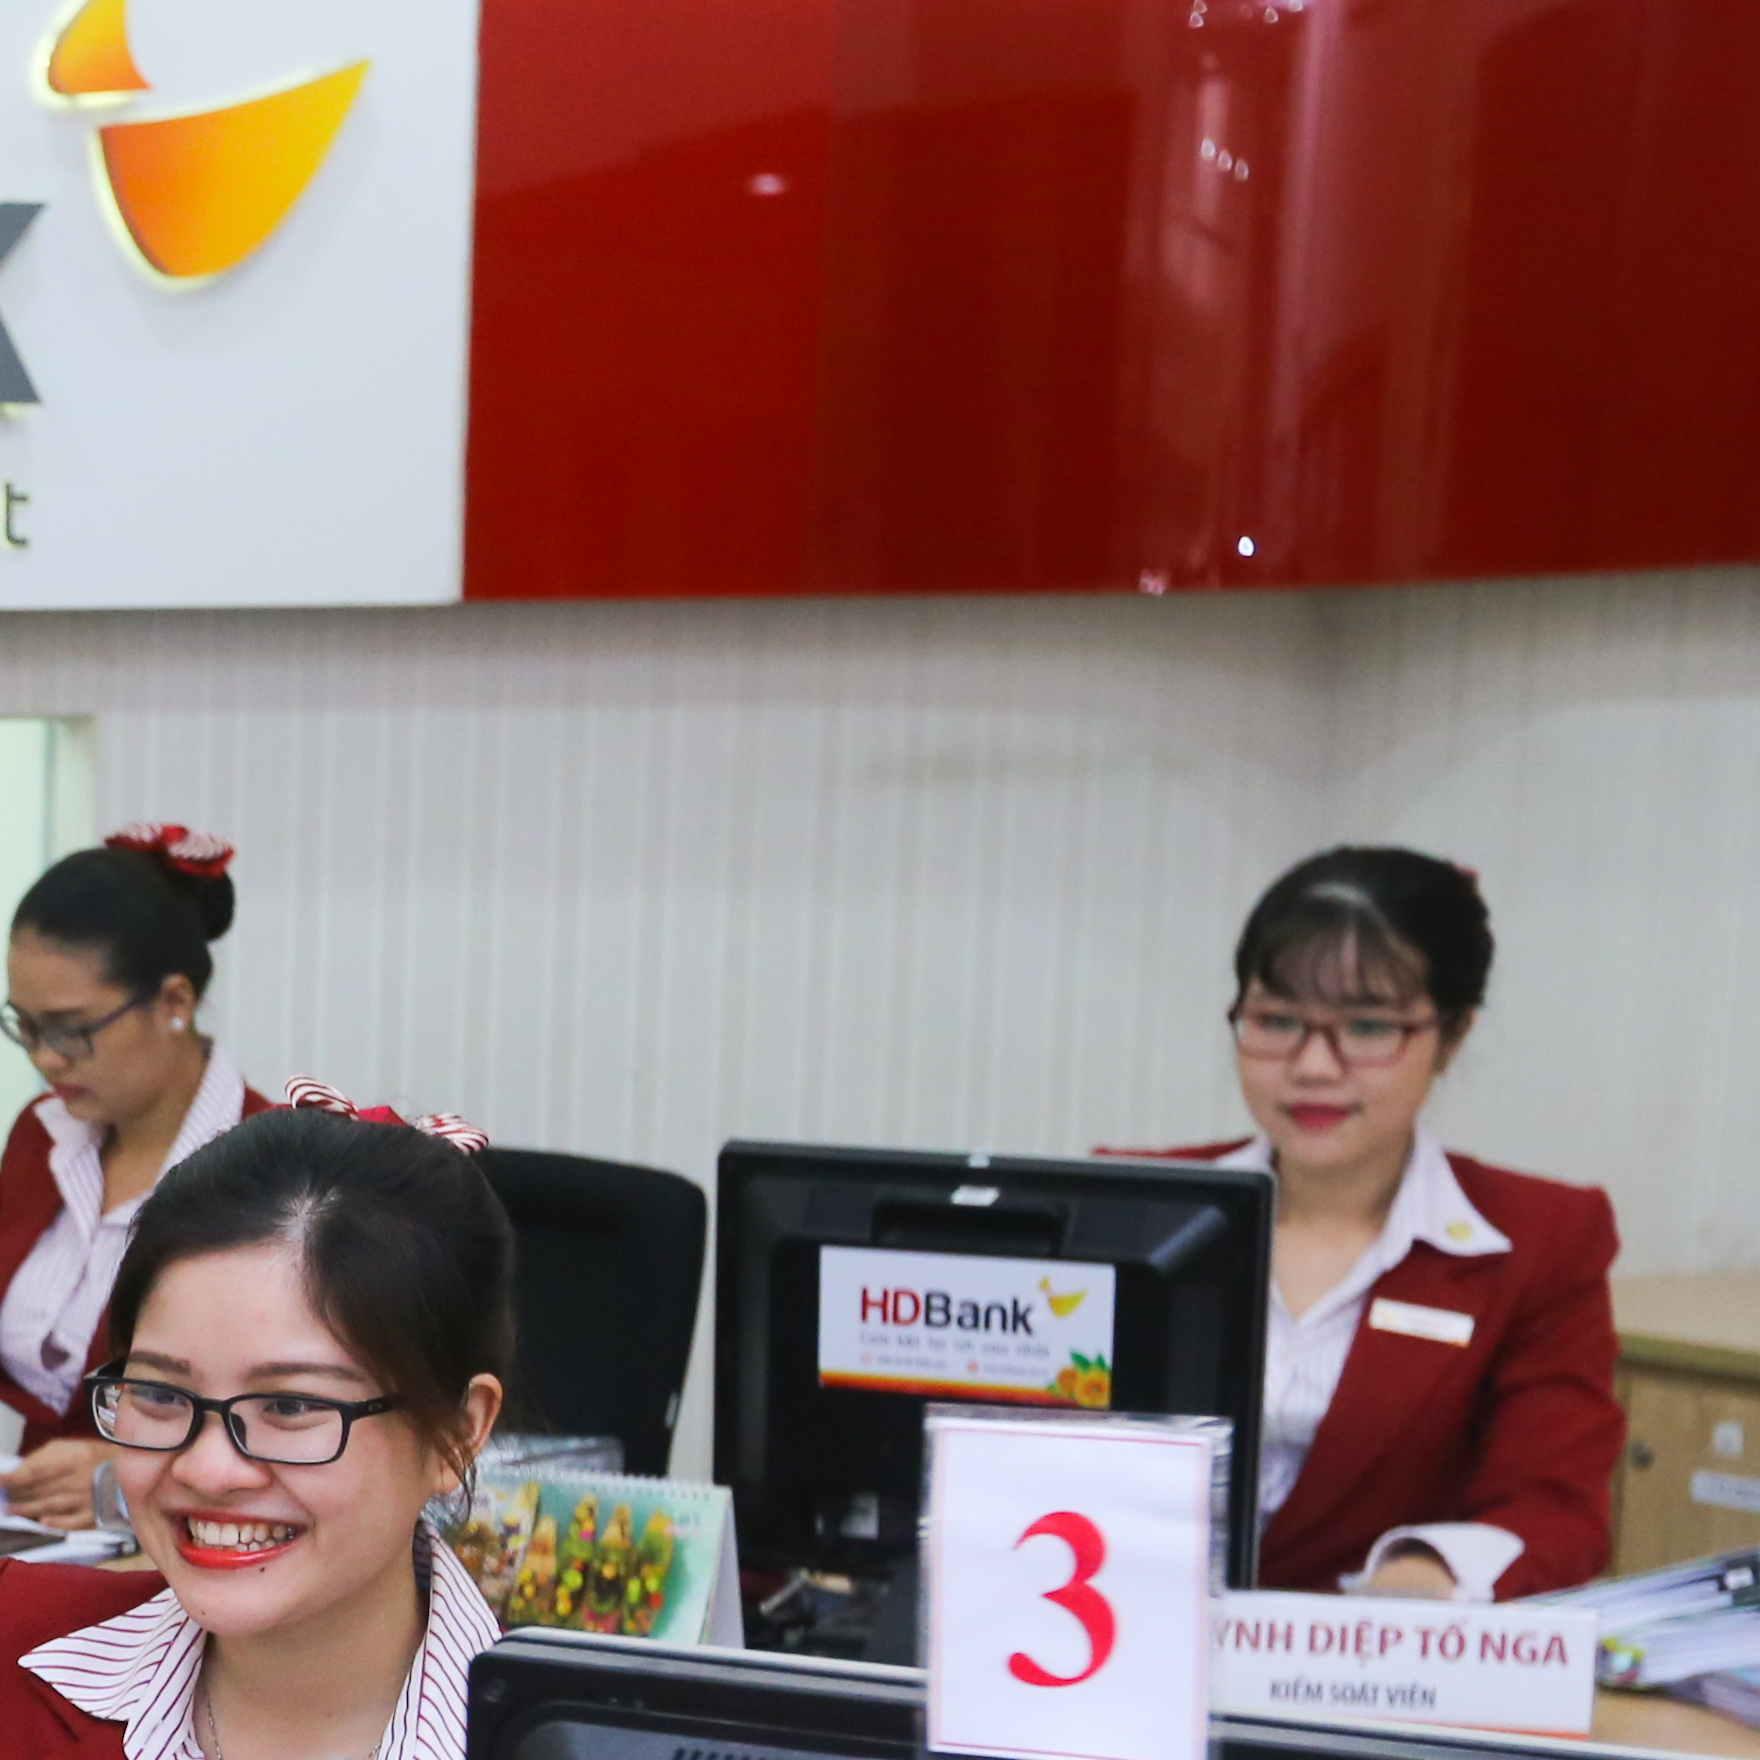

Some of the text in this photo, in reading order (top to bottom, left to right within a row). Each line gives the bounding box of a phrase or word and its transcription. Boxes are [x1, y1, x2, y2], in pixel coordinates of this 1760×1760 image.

[860, 1287, 1033, 1335] HDBank
[1007, 1510, 1116, 1686] 3
[1214, 1618, 1293, 1651] YNH
[1309, 1618, 1402, 1668] DIỆP
[1480, 1630, 1568, 1665] NGA
